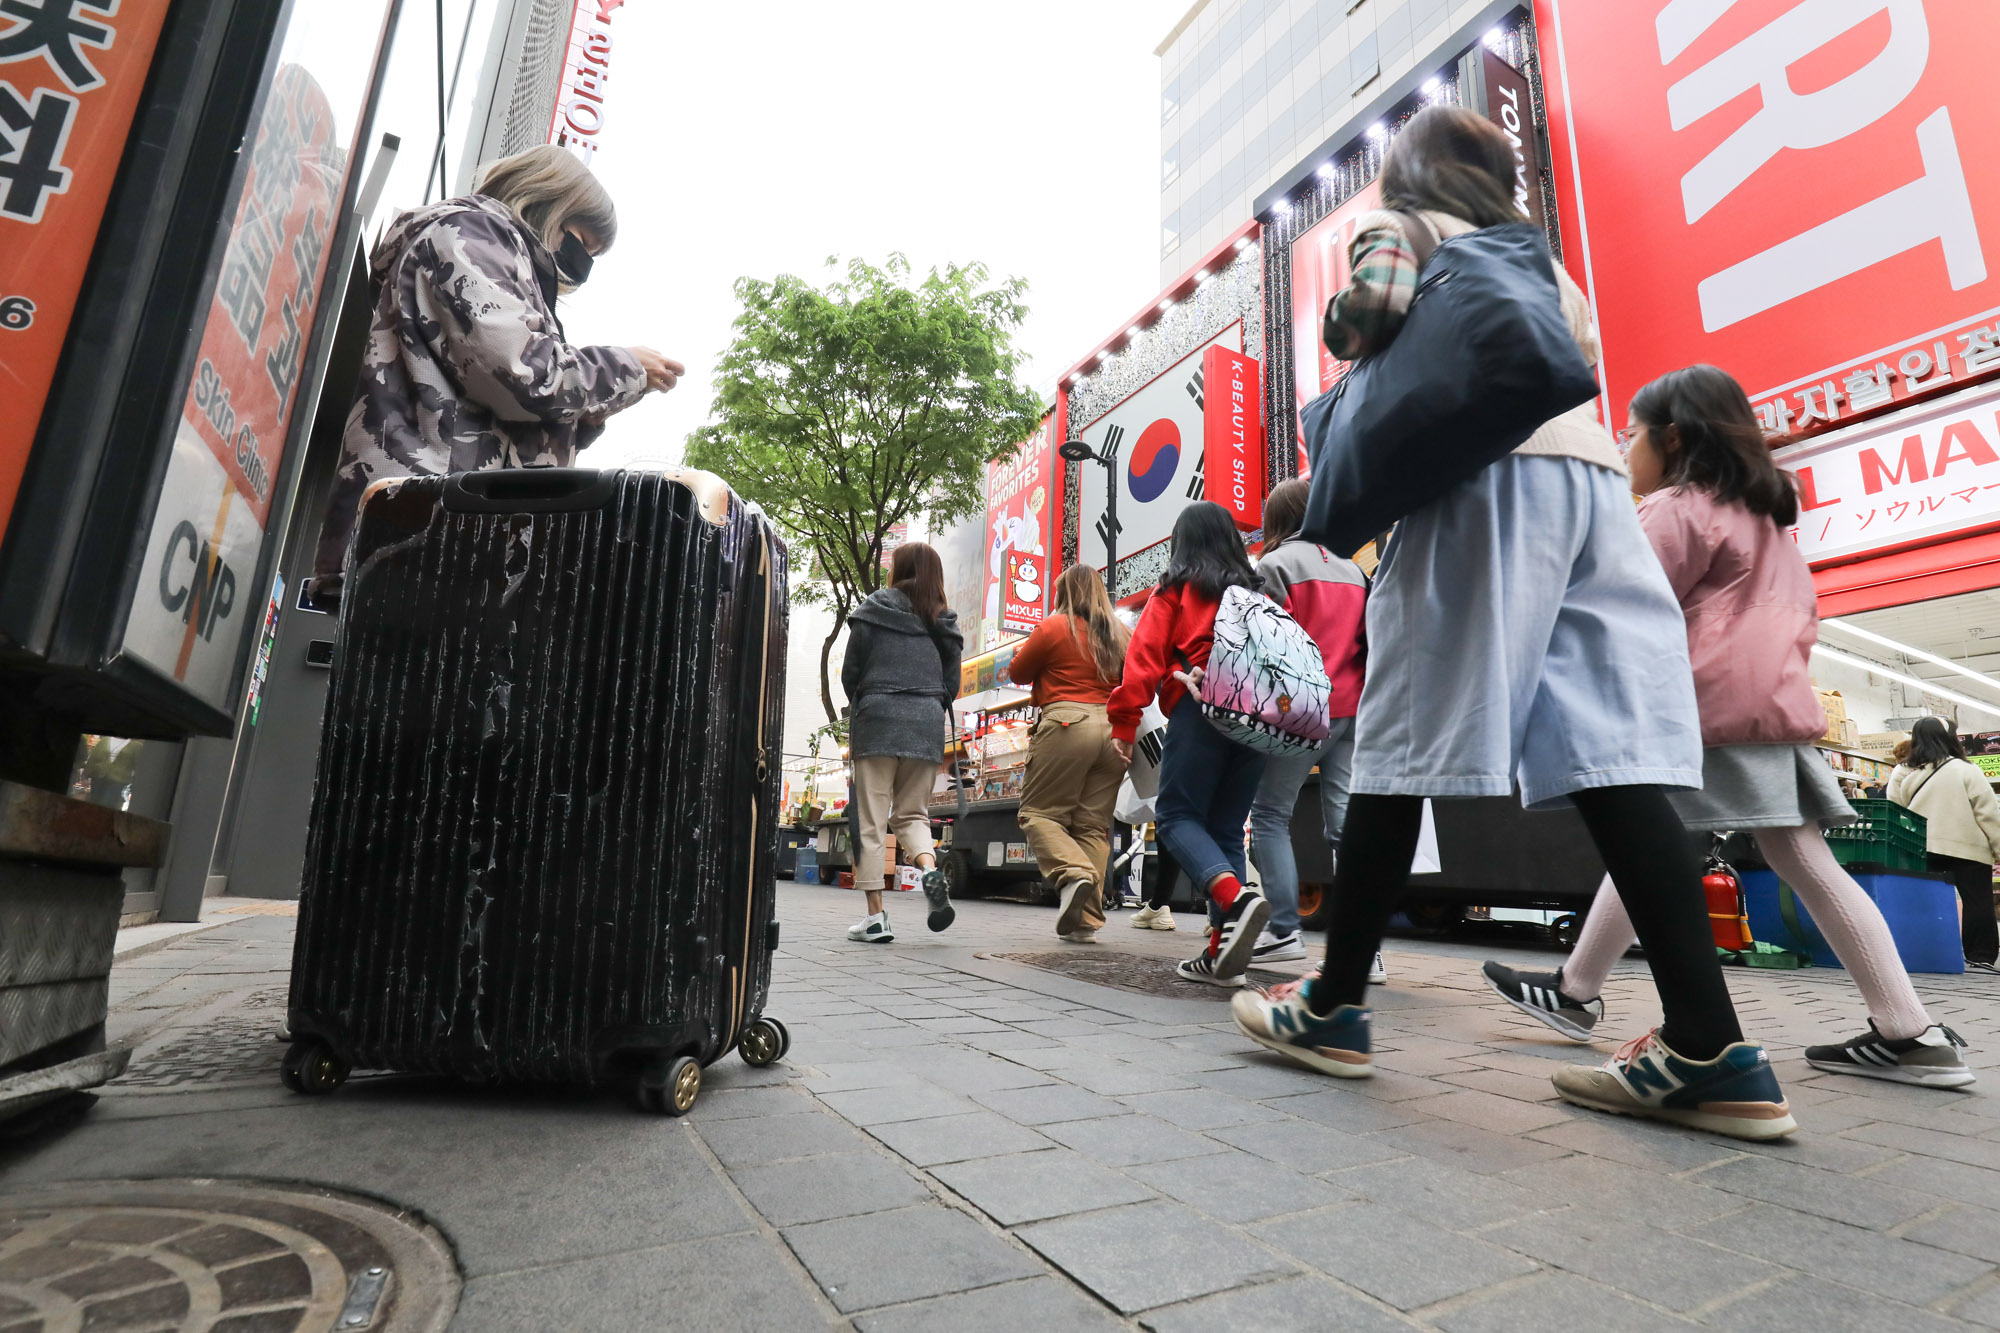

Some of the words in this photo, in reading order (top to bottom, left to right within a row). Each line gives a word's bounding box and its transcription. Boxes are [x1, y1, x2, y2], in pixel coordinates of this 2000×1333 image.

[1655, 0, 1988, 334] RT
[194, 357, 236, 448] Skin
[235, 420, 270, 505] Clinic
[1231, 359, 1245, 454] K-BEAUTY
[990, 458, 1039, 512] FAVORITES
[991, 424, 1049, 496] FOREVER
[1232, 458, 1245, 512] SHOP
[159, 519, 236, 644] CNP
[1005, 602, 1043, 619] MIXUE
